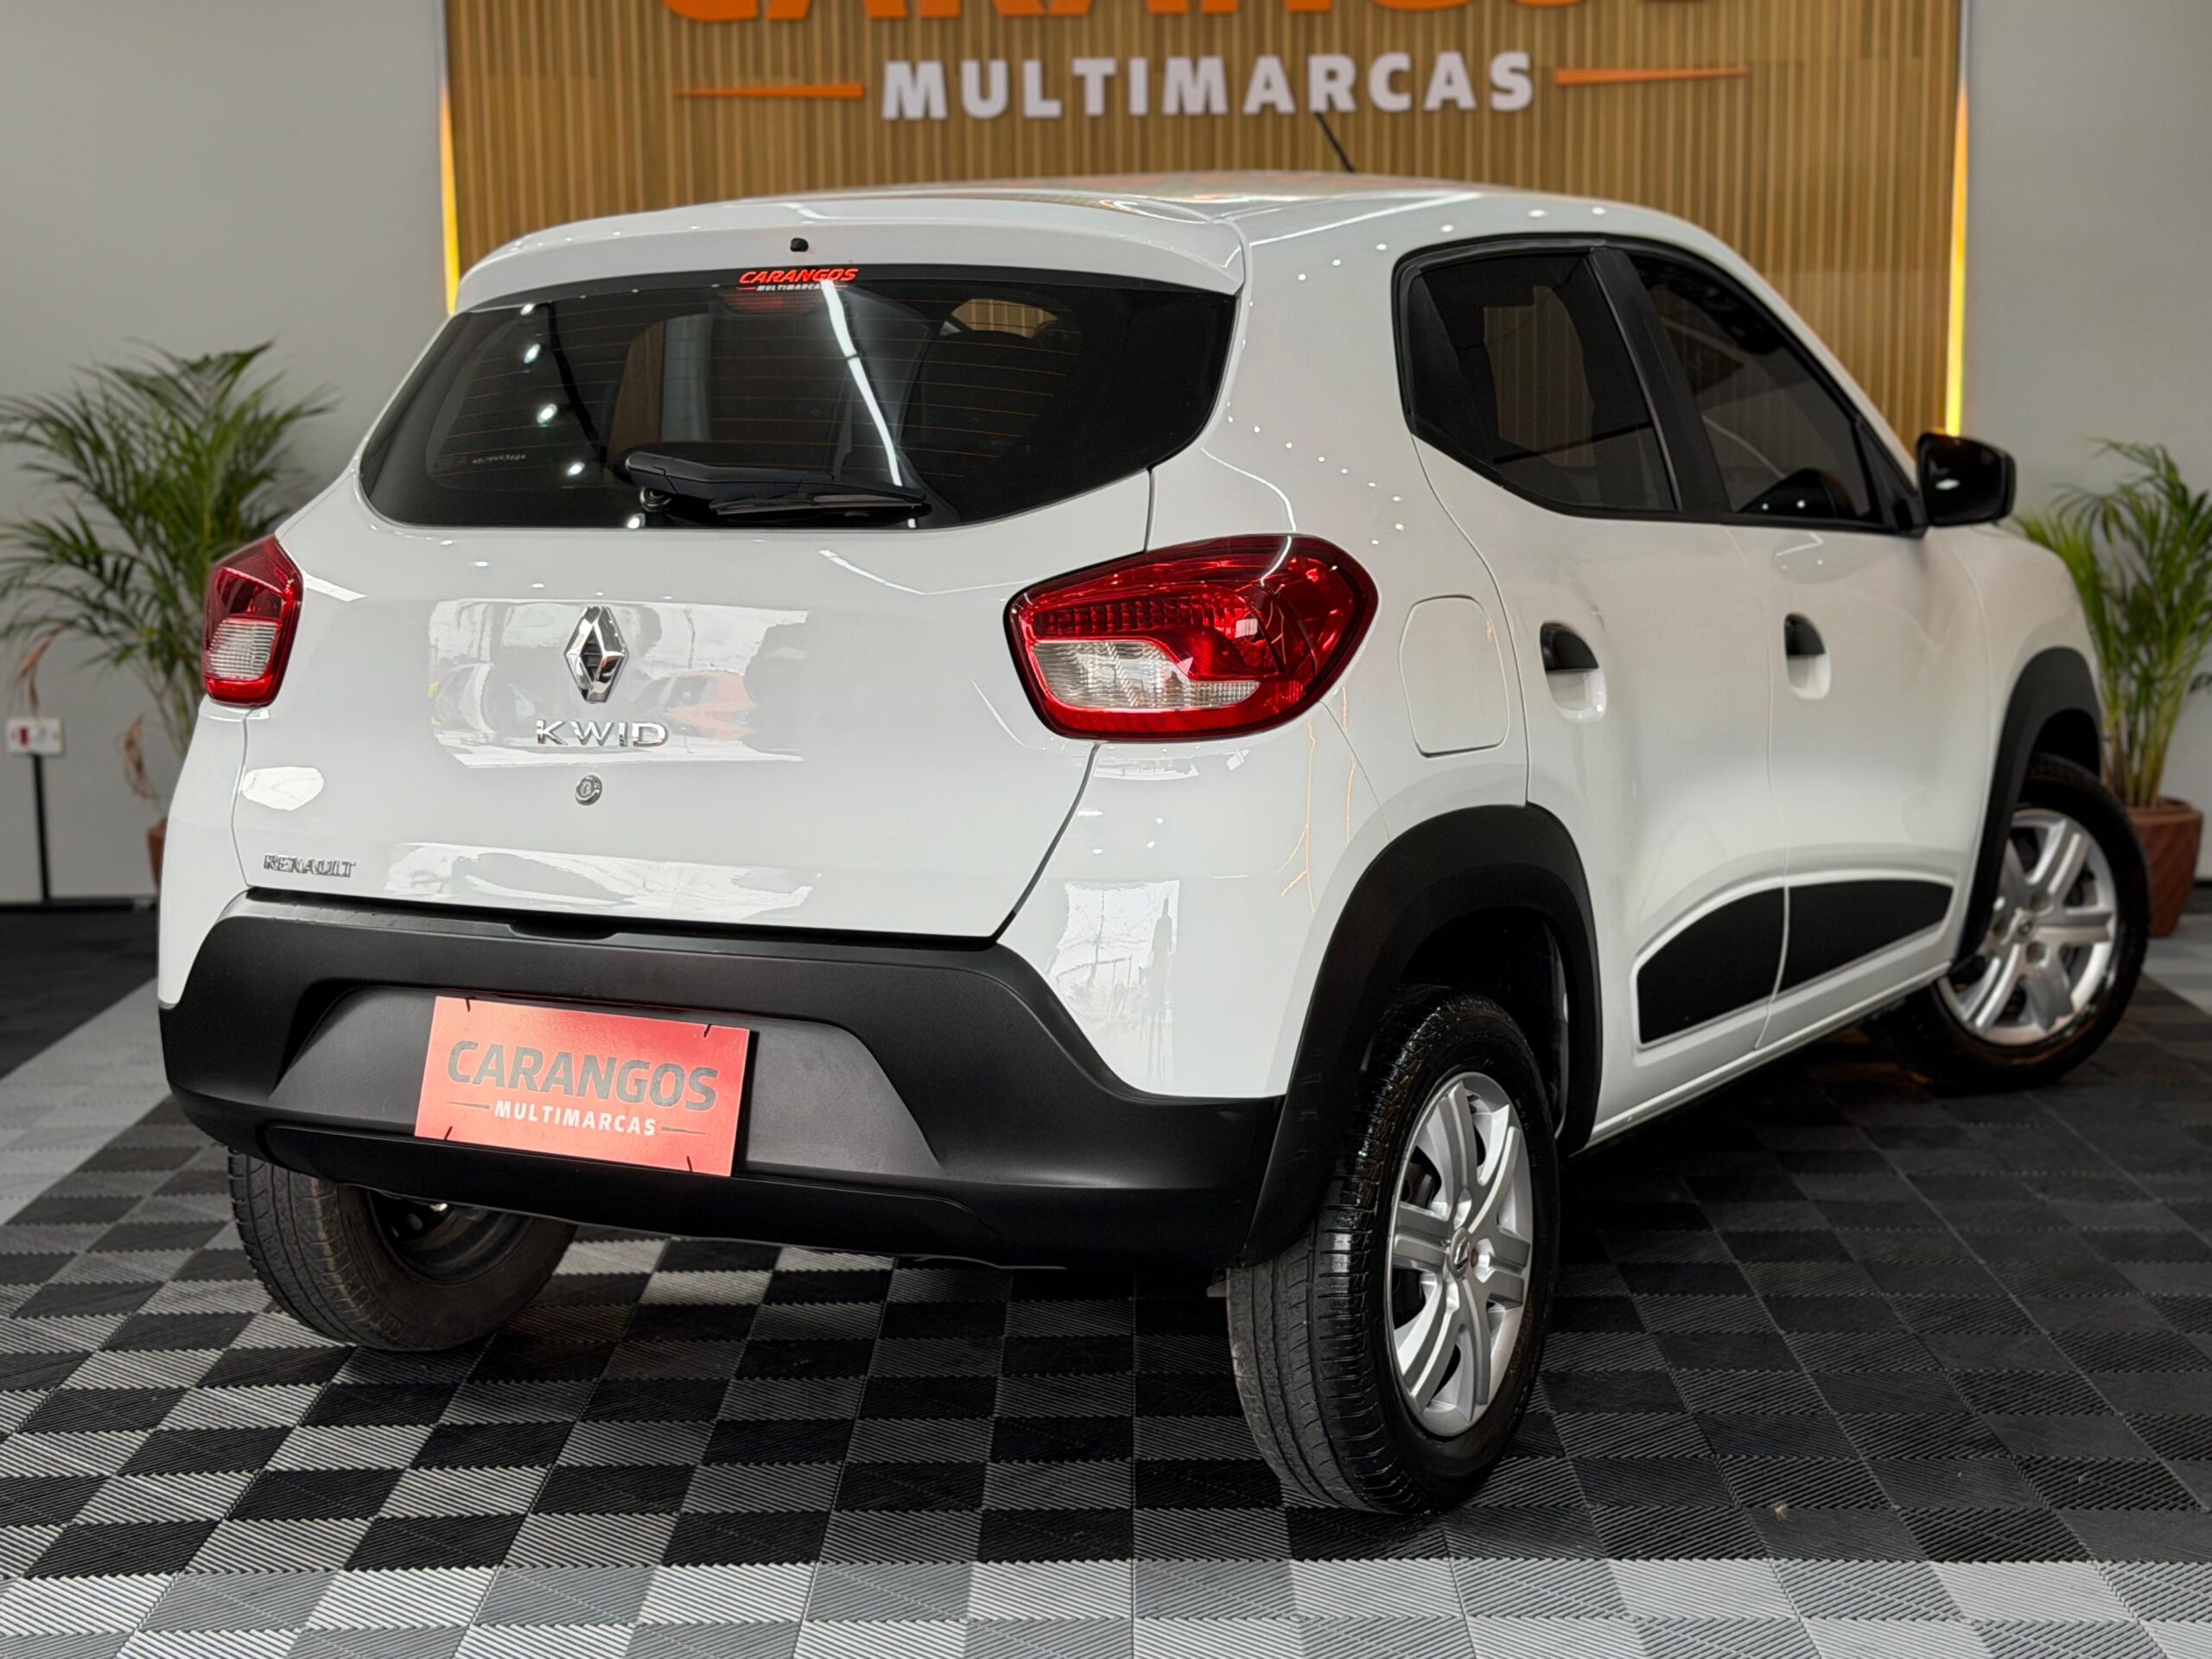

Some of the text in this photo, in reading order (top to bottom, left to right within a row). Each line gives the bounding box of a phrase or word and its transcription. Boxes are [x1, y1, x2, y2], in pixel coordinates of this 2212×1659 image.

[880, 50, 1535, 121] MULTIMARCAS
[739, 269, 859, 283] CARANGOS
[536, 719, 669, 747] KWID
[264, 854, 356, 878] RENAULT
[447, 1039, 719, 1112] CARANGOS
[493, 1099, 658, 1137] MULTIMARCAS
